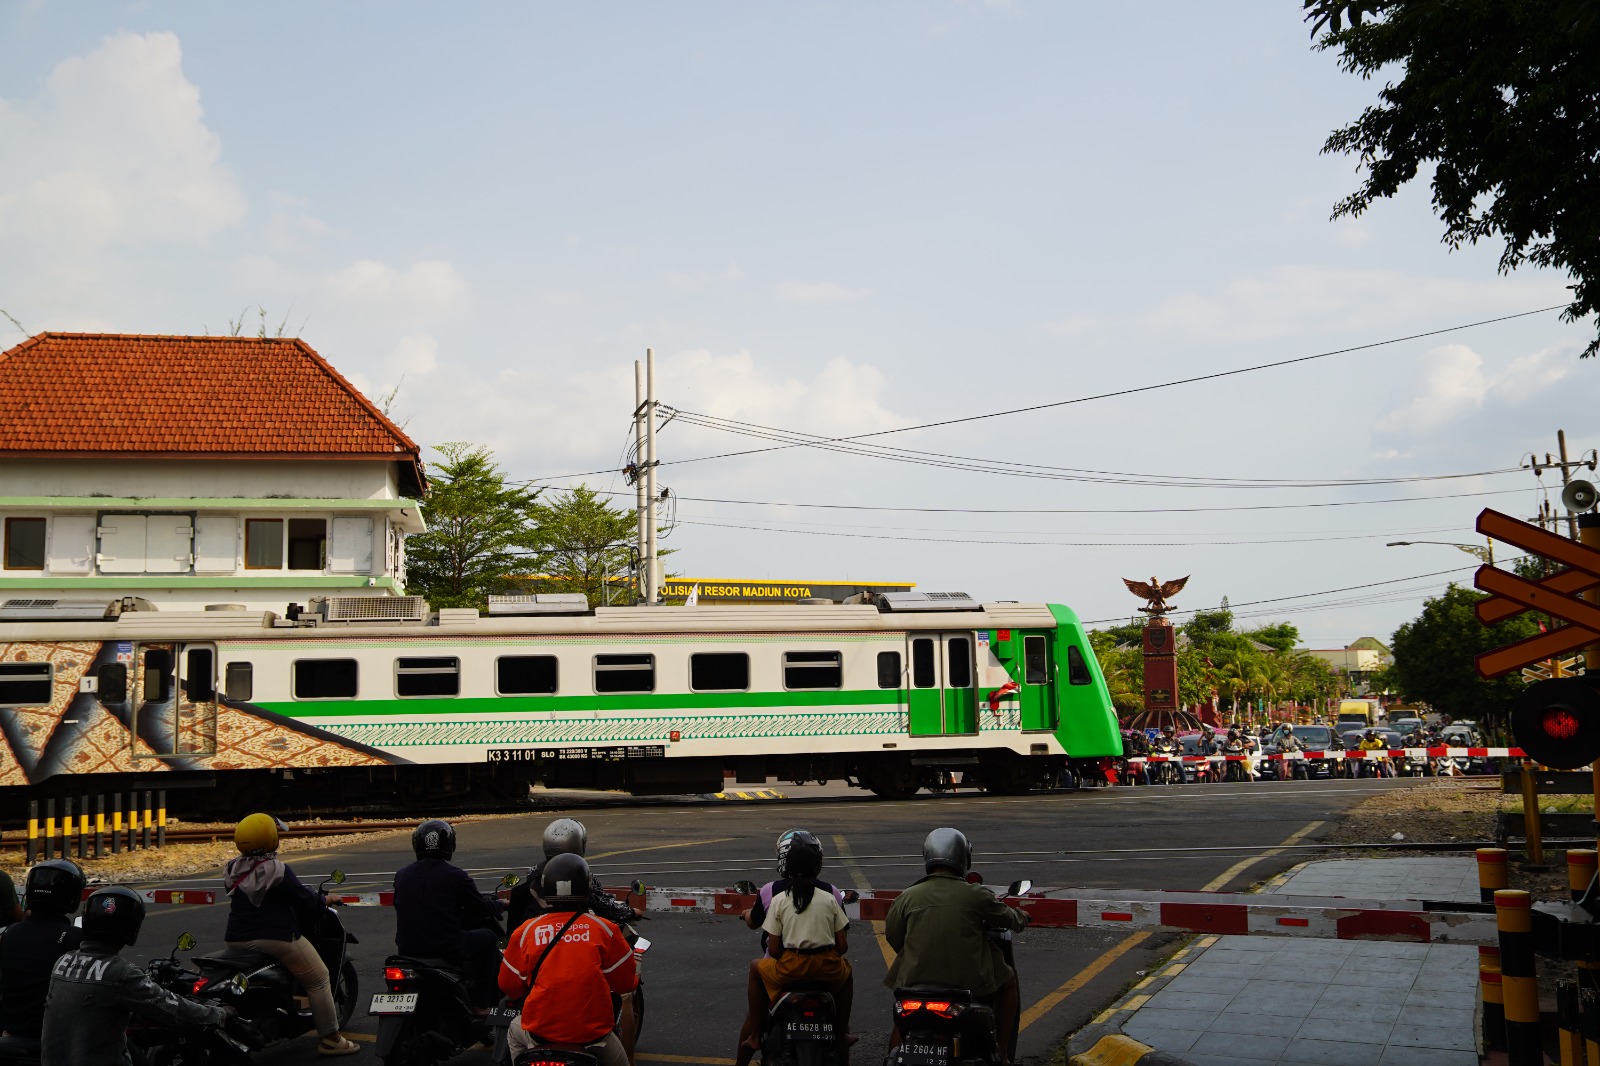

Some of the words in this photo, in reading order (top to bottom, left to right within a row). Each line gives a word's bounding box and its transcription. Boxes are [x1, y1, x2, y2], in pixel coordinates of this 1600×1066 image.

[660, 585, 702, 596] OLISIAN
[705, 587, 740, 597] RESOR
[742, 587, 782, 597] MADIUN
[784, 587, 812, 597] KOTA
[86, 679, 92, 689] 1
[488, 750, 502, 762] K3
[503, 750, 510, 761] 3
[512, 749, 522, 761] 11
[524, 749, 535, 761] 01
[555, 930, 590, 944] ood
[374, 995, 385, 1003] AE
[386, 995, 405, 1003] 3213
[489, 1007, 499, 1016] AE
[787, 1022, 797, 1031] AE
[799, 1023, 819, 1032] 6628
[899, 1044, 911, 1054] AE
